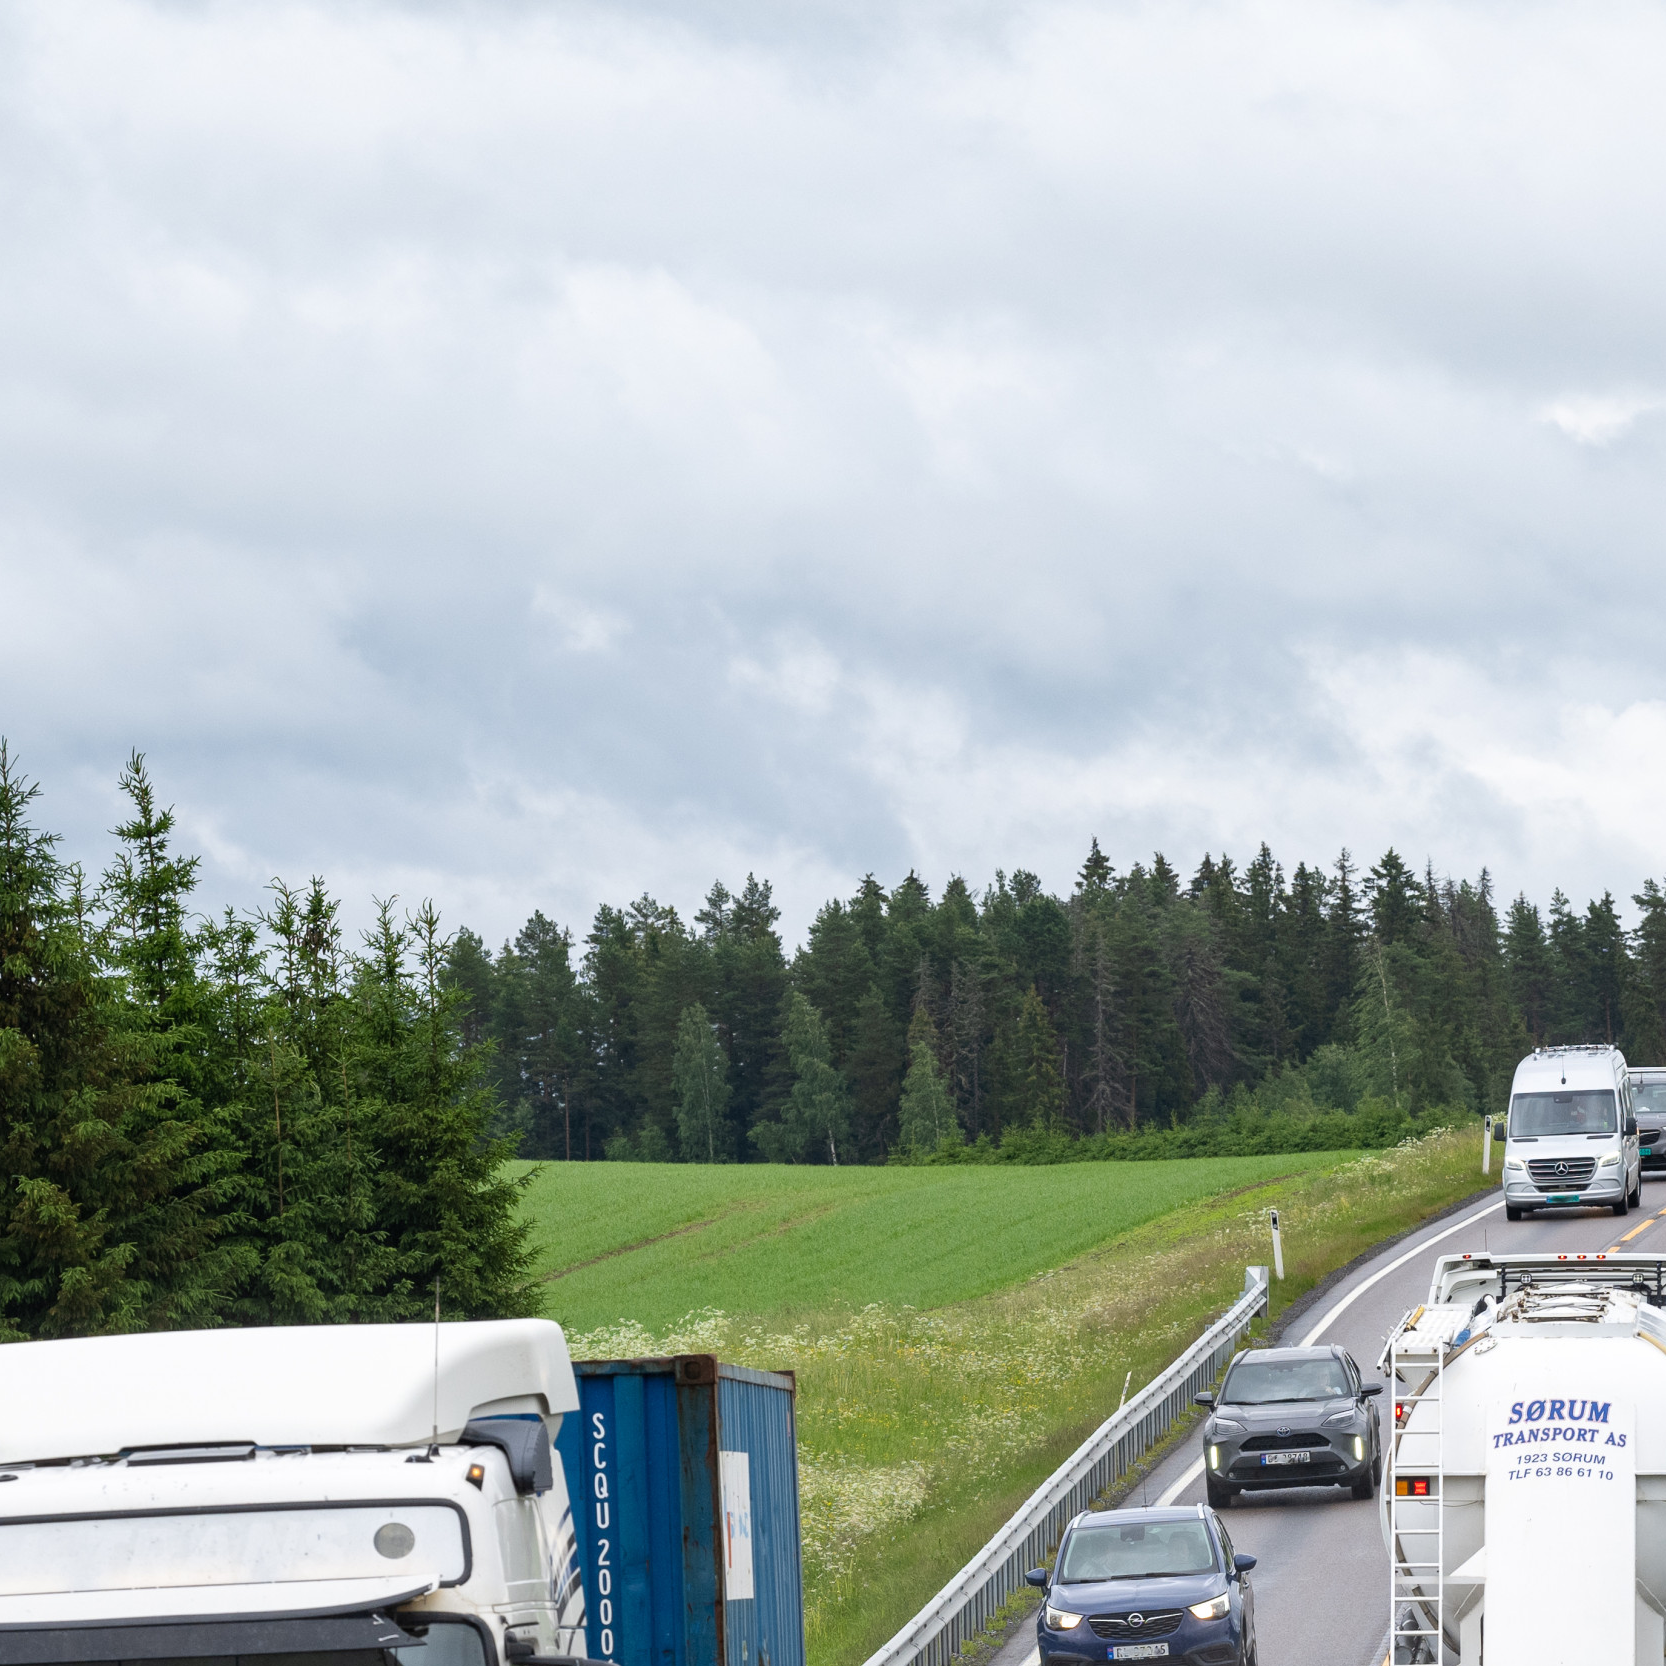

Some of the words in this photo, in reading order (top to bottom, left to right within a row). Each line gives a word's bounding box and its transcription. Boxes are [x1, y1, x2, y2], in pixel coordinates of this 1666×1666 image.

[1507, 1399, 1612, 1425] SØRUM
[1493, 1427, 1599, 1449] TRANSPORT
[1604, 1431, 1627, 1448] AS
[592, 1412, 610, 1529] SCQU
[1516, 1453, 1548, 1465] 1923
[1552, 1452, 1606, 1465] SØRUM
[1508, 1468, 1532, 1481] TLF
[1535, 1467, 1552, 1477] 63
[1556, 1467, 1573, 1477] 86
[1577, 1468, 1592, 1478] 61
[1598, 1470, 1614, 1481] 10
[597, 1538, 614, 1664] 2000
